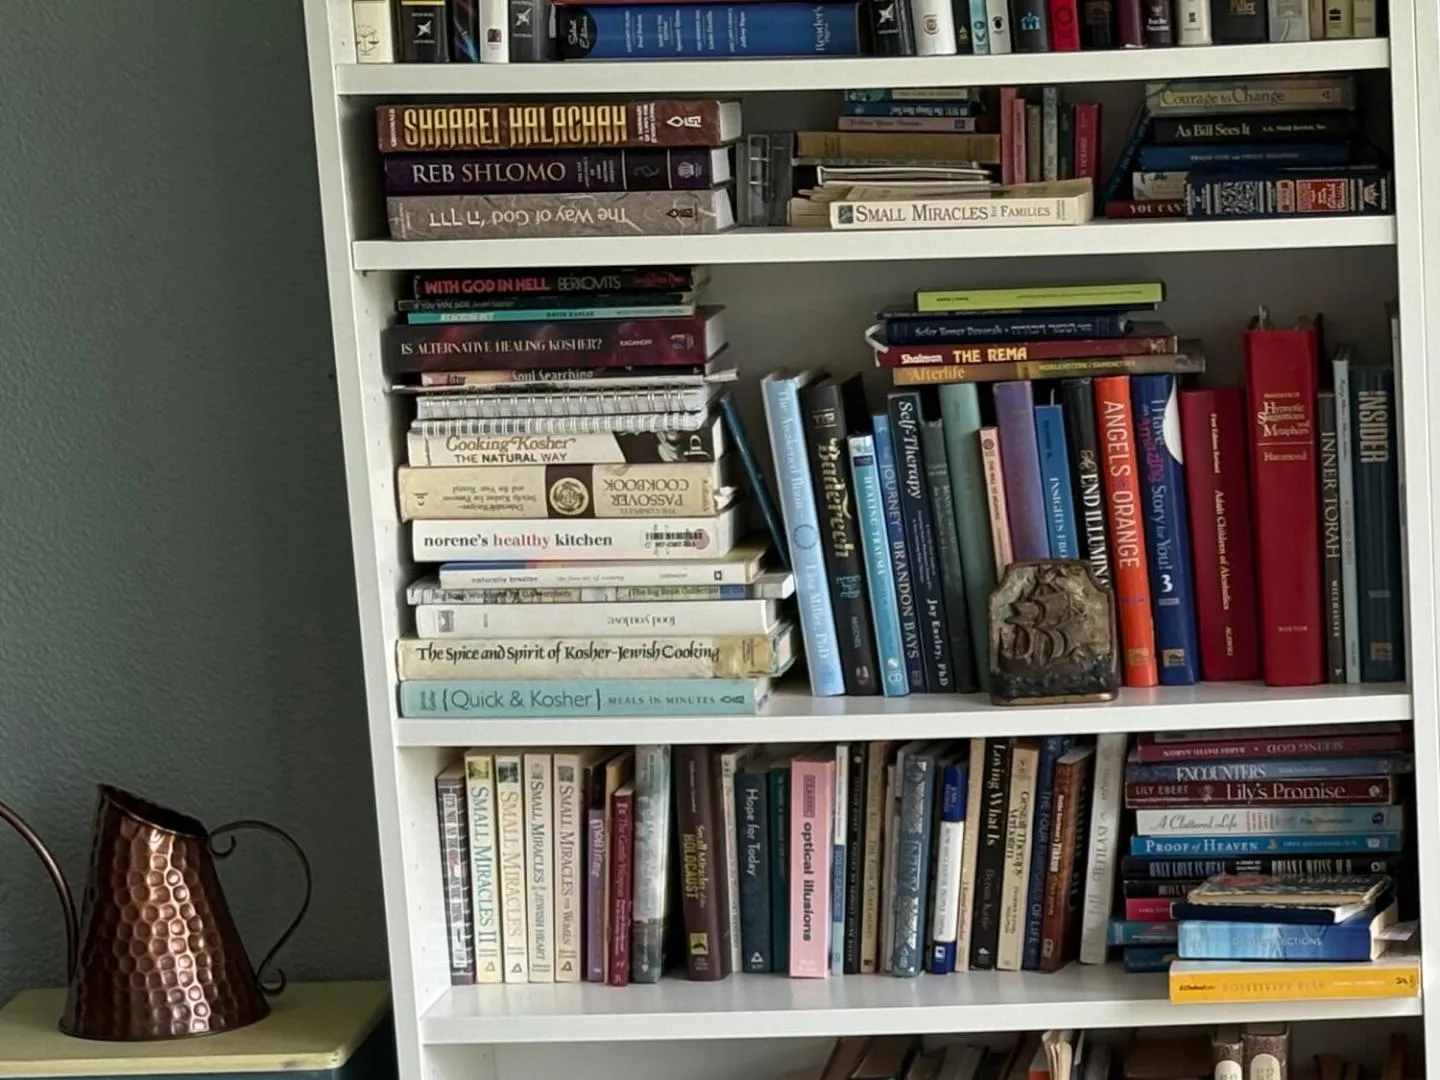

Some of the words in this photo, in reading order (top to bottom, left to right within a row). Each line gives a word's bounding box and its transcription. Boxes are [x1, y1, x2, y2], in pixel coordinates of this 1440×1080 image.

[1161, 89, 1217, 109] Courage
[1232, 86, 1285, 106] Change
[404, 106, 499, 146] SHAAREI
[509, 104, 628, 145] HALACHAH
[1176, 124, 1191, 138] As
[1192, 123, 1216, 138] Bill
[1218, 123, 1239, 137] Sees
[413, 164, 455, 183] REB
[461, 161, 566, 183] SHLOMO
[495, 211, 529, 227] God
[534, 210, 554, 227] of
[559, 208, 593, 226] Way
[597, 207, 627, 225] The
[856, 204, 907, 223] SMALL
[911, 201, 989, 222] MIRACLES
[1000, 204, 1052, 219] FAMILIES
[425, 280, 458, 294] WITH
[461, 279, 495, 293] GOD
[498, 279, 512, 292] IN
[515, 278, 551, 291] HELL
[557, 276, 621, 291] BERKOVITS
[401, 342, 413, 356] IS
[414, 340, 492, 355] ALTERNATIVE
[495, 339, 545, 353] HEALING
[548, 338, 603, 352] KOSHER?
[953, 350, 980, 364] THE
[988, 347, 1027, 361] REMA
[910, 367, 965, 381] Afterlife
[446, 435, 510, 454] Cooking
[516, 435, 576, 451] Kosher
[1103, 401, 1129, 477] ANGELS
[455, 454, 479, 462] THE
[482, 452, 538, 462] NATURAL
[541, 452, 567, 462] WAY
[899, 401, 922, 500] Self-Therapy
[1322, 432, 1337, 489] INNER
[603, 478, 689, 491] COOKBOOK
[612, 494, 684, 507] PASSOVER
[1112, 490, 1140, 568] ORANGE
[1325, 495, 1341, 559] TORAH
[424, 534, 489, 548] norene's
[493, 533, 551, 549] healthy
[554, 533, 613, 547] kitchen
[416, 647, 444, 662] The
[446, 646, 478, 664] Spice
[480, 644, 505, 661] and
[507, 643, 545, 662] Spirit
[548, 642, 561, 664] of
[662, 643, 720, 663] Cooking
[1227, 782, 1267, 800] Lily's
[1273, 782, 1346, 800] Promise
[470, 787, 489, 841] SMALL
[558, 785, 573, 829] SMALL
[802, 822, 815, 875] optical
[1146, 840, 1189, 852] PROOF
[1192, 842, 1200, 851] of
[1204, 839, 1258, 851] HEAVEN
[560, 832, 575, 896] MIRACLES
[475, 846, 494, 927] MIRACLES
[802, 879, 814, 942] illusions
[478, 930, 496, 944] II
